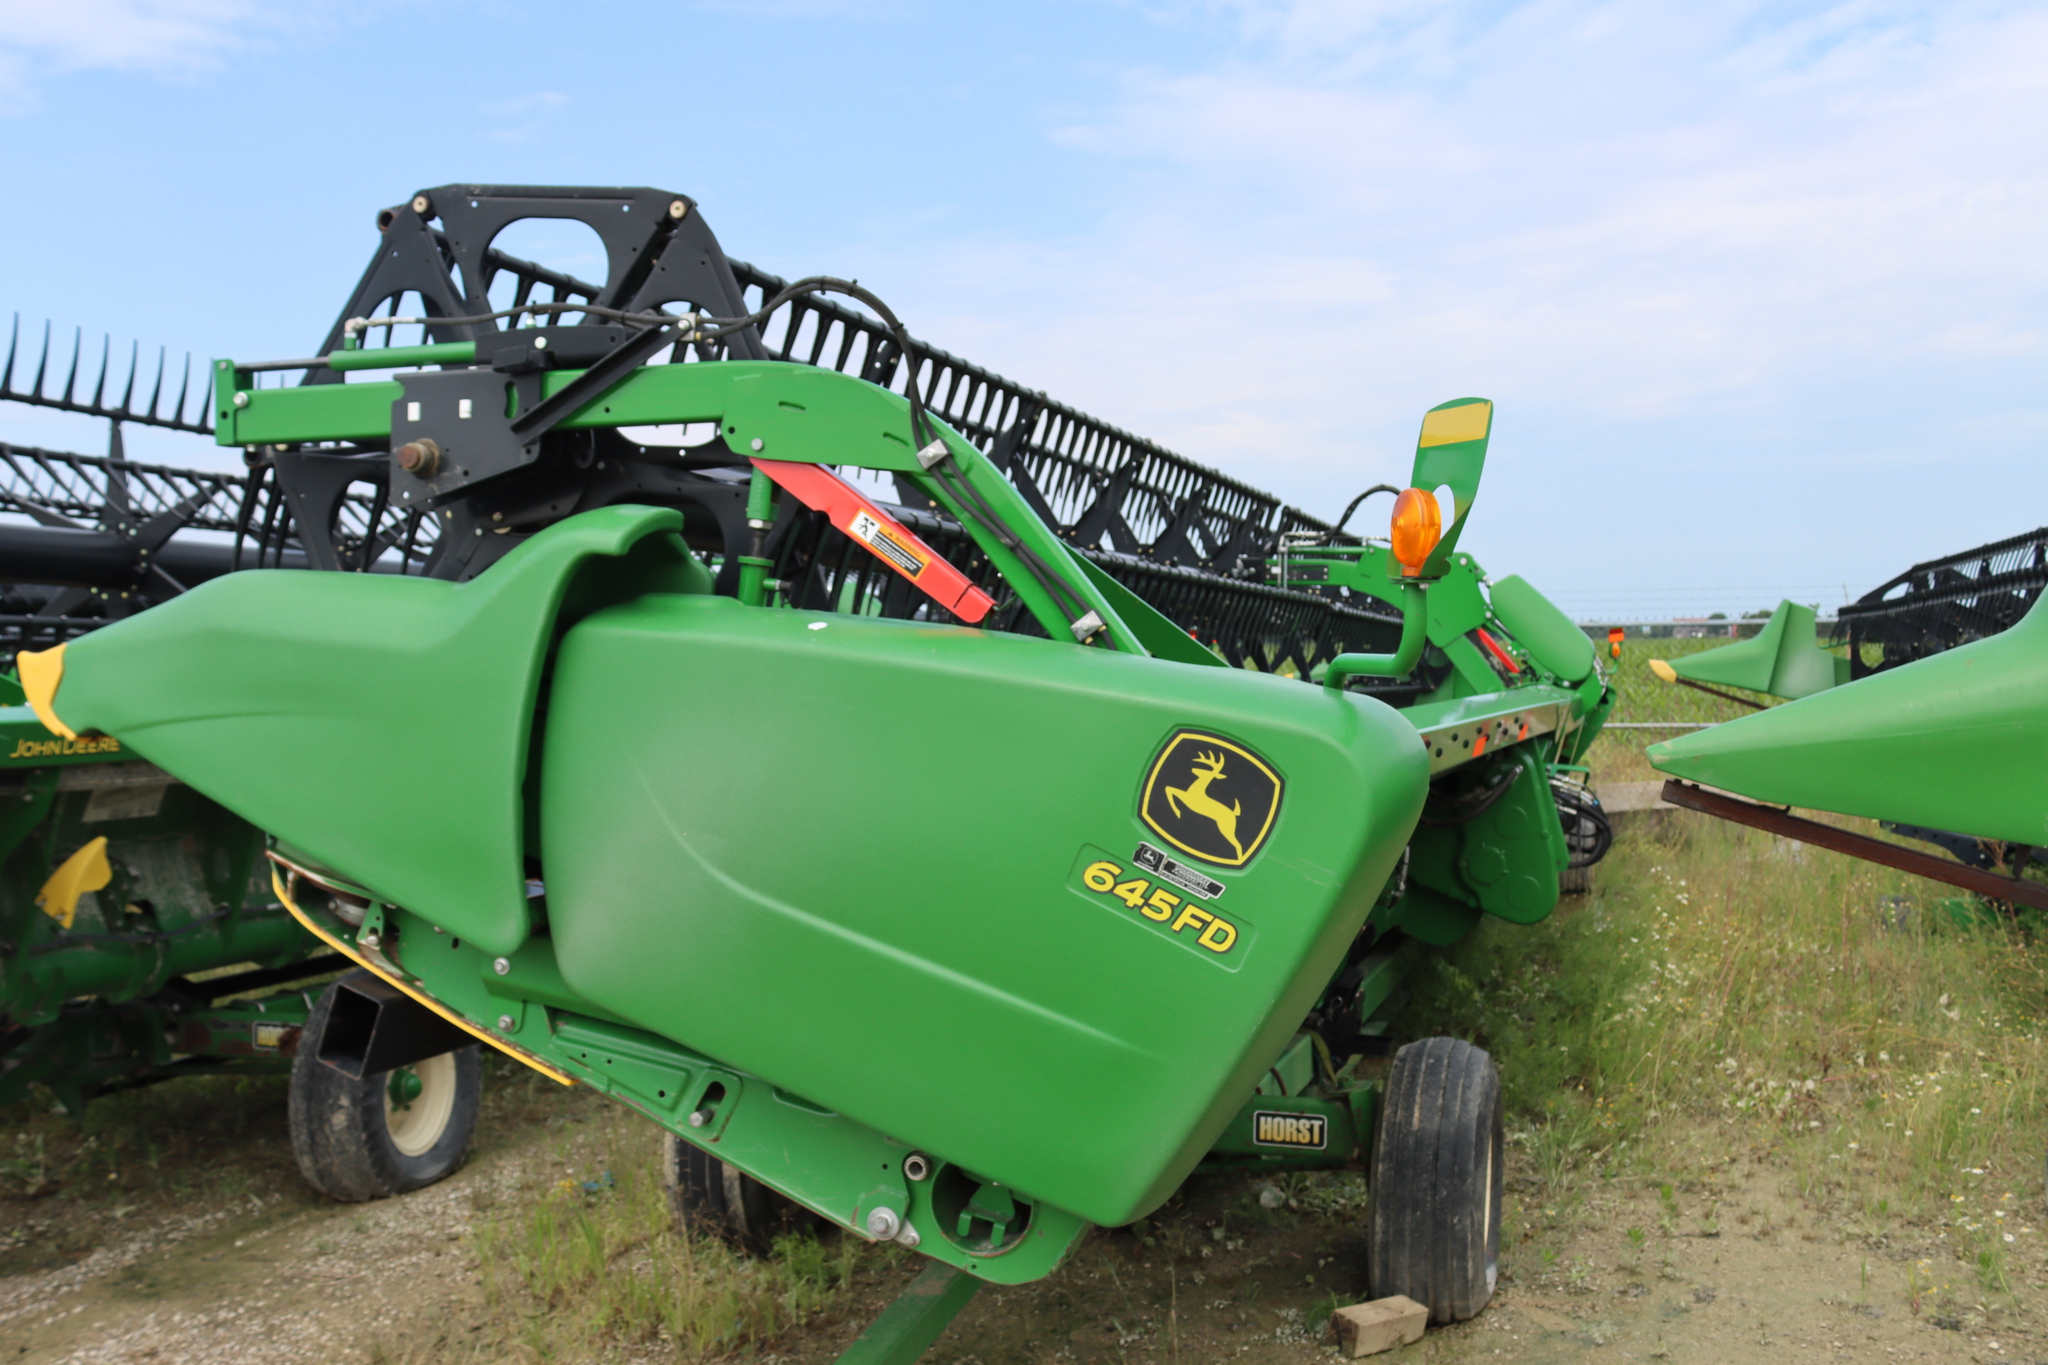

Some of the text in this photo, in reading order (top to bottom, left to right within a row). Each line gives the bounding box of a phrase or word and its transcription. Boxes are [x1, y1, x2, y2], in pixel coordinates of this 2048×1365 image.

[894, 535, 922, 558] WARNING
[9, 739, 60, 758] JOHN
[1259, 1116, 1323, 1144] HORST
